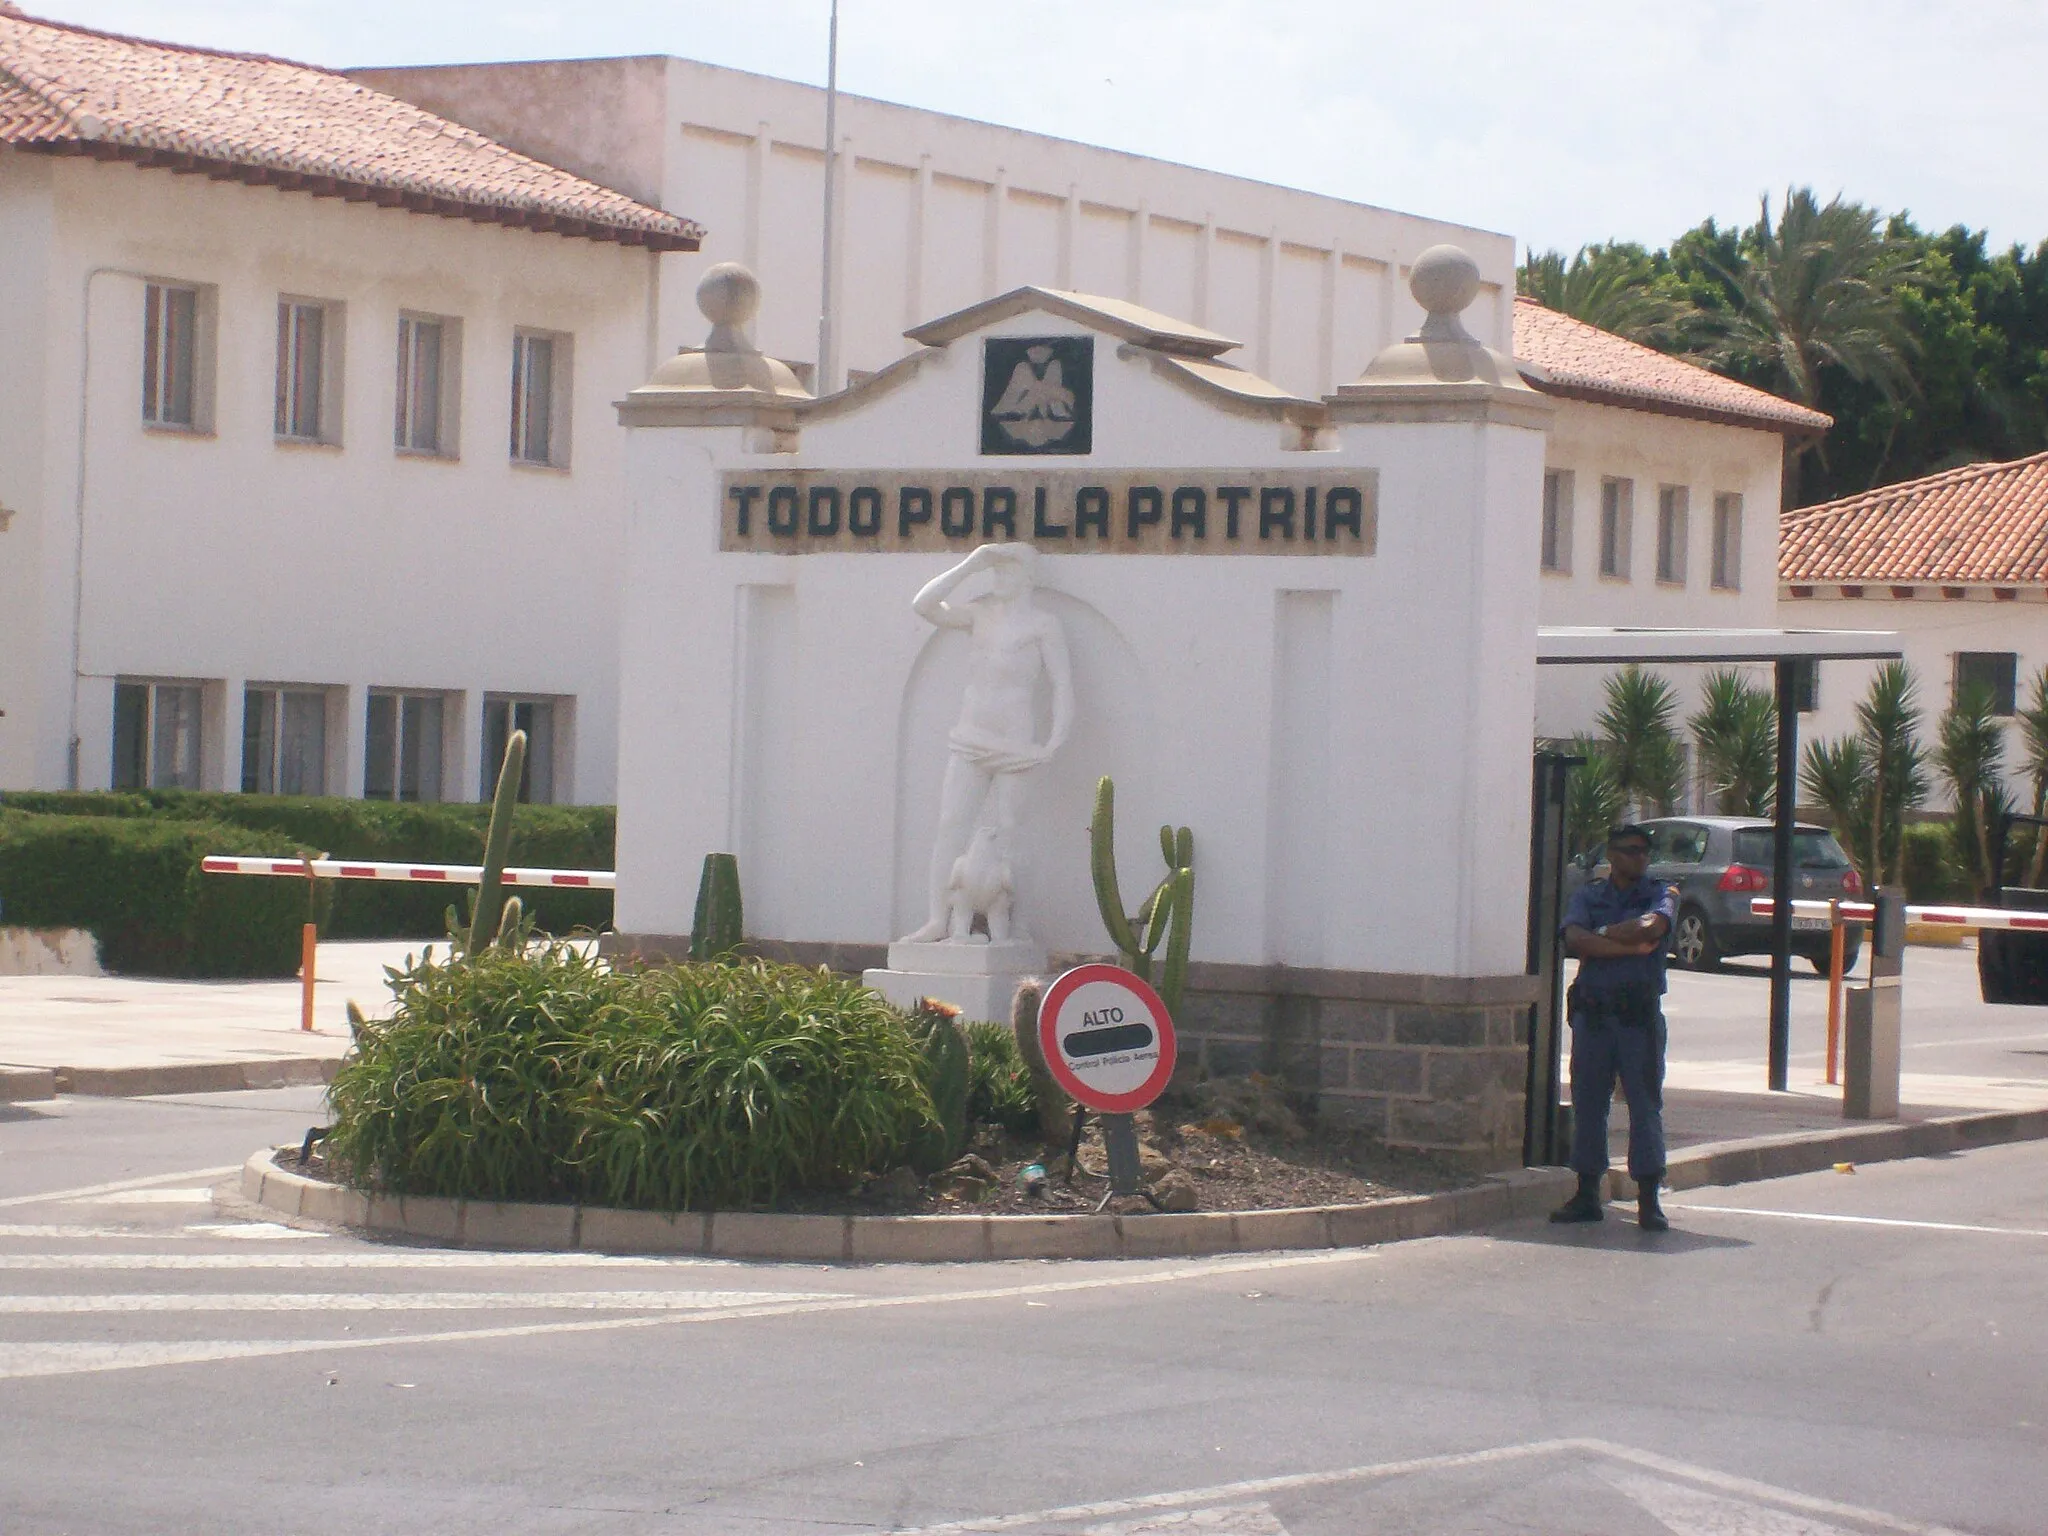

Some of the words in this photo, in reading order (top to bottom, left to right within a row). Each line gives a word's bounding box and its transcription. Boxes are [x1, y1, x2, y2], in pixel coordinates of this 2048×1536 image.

[729, 486, 882, 538] TODO
[898, 487, 1017, 540] POR
[1034, 487, 1110, 540] LA
[1126, 486, 1364, 541] PATRIA
[1083, 1007, 1124, 1027] ALTO
[1069, 1058, 1100, 1071] Control
